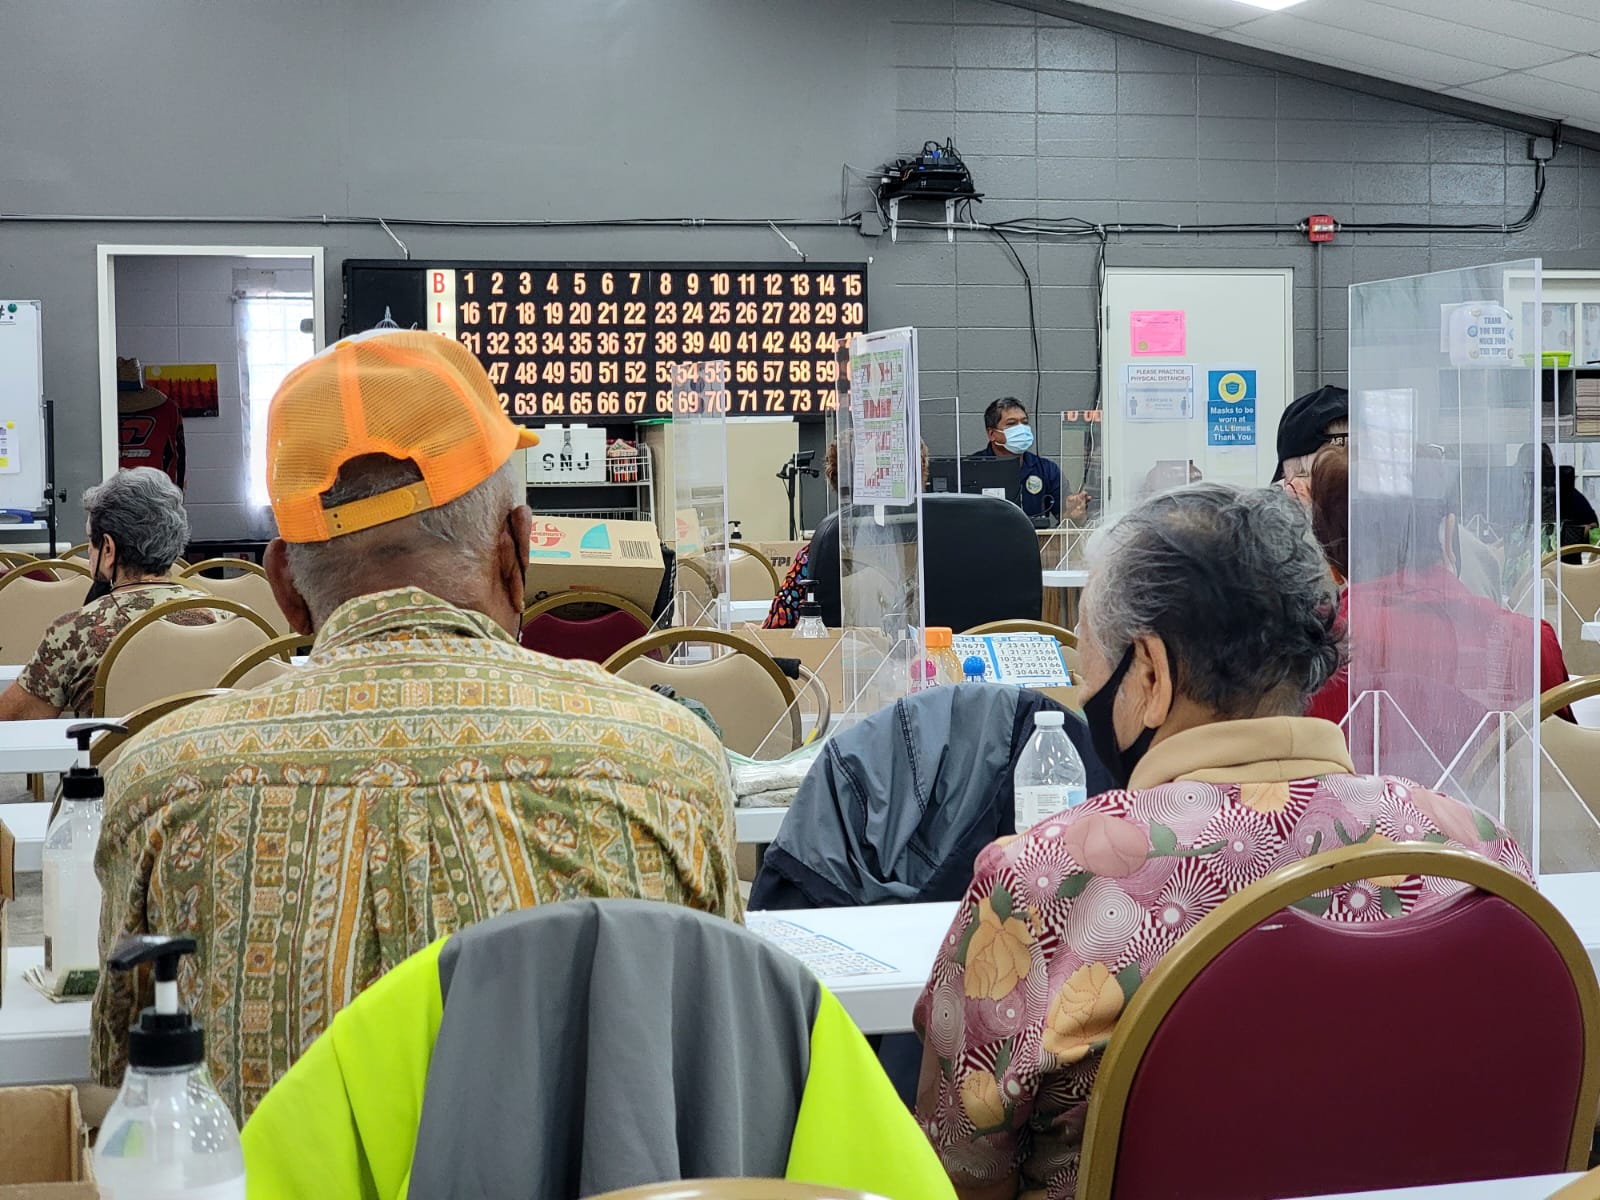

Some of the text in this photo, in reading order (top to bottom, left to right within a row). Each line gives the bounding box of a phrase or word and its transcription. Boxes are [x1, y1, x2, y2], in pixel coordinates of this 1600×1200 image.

[433, 272, 861, 295] B 1 2 3 4 5 6 7 8 9 10 11 12 13 14 15
[436, 302, 863, 325] I 16 17 18 19 20 21 22 23 24 25 26 27 28 29 30
[461, 332, 481, 354] 31
[487, 332, 509, 354] 32
[515, 332, 537, 354] 33
[542, 332, 564, 354] 34
[570, 332, 592, 354] 35
[597, 332, 619, 354] 36
[624, 332, 646, 354] 37
[655, 332, 677, 353] 38
[682, 331, 704, 353] 39
[709, 331, 731, 353] 40
[737, 332, 756, 353] 41
[762, 331, 784, 353] 42
[790, 331, 811, 353] 43
[816, 331, 839, 353] 44
[488, 362, 509, 384] 47
[515, 362, 537, 384] 48
[542, 362, 564, 383] 49
[570, 362, 592, 383] 50
[599, 362, 618, 383] 51
[625, 361, 646, 383] 52
[656, 361, 675, 382] 53
[677, 363, 698, 384] 54
[704, 361, 731, 383] 55
[736, 361, 758, 382] 56
[763, 361, 784, 382] 57
[790, 360, 811, 382] 58
[816, 361, 839, 383] 59
[515, 393, 537, 415] 63
[542, 392, 564, 414] 64
[570, 392, 592, 414] 65
[597, 392, 619, 413] 66
[625, 392, 646, 413] 67
[656, 390, 674, 412] 68
[678, 392, 699, 412] 69
[704, 390, 731, 412] 70
[738, 390, 757, 411] 71
[763, 390, 784, 411] 72
[790, 389, 811, 411] 73
[818, 390, 839, 412] 74
[1210, 406, 1254, 414] Masks to be
[771, 556, 791, 567] TPI
